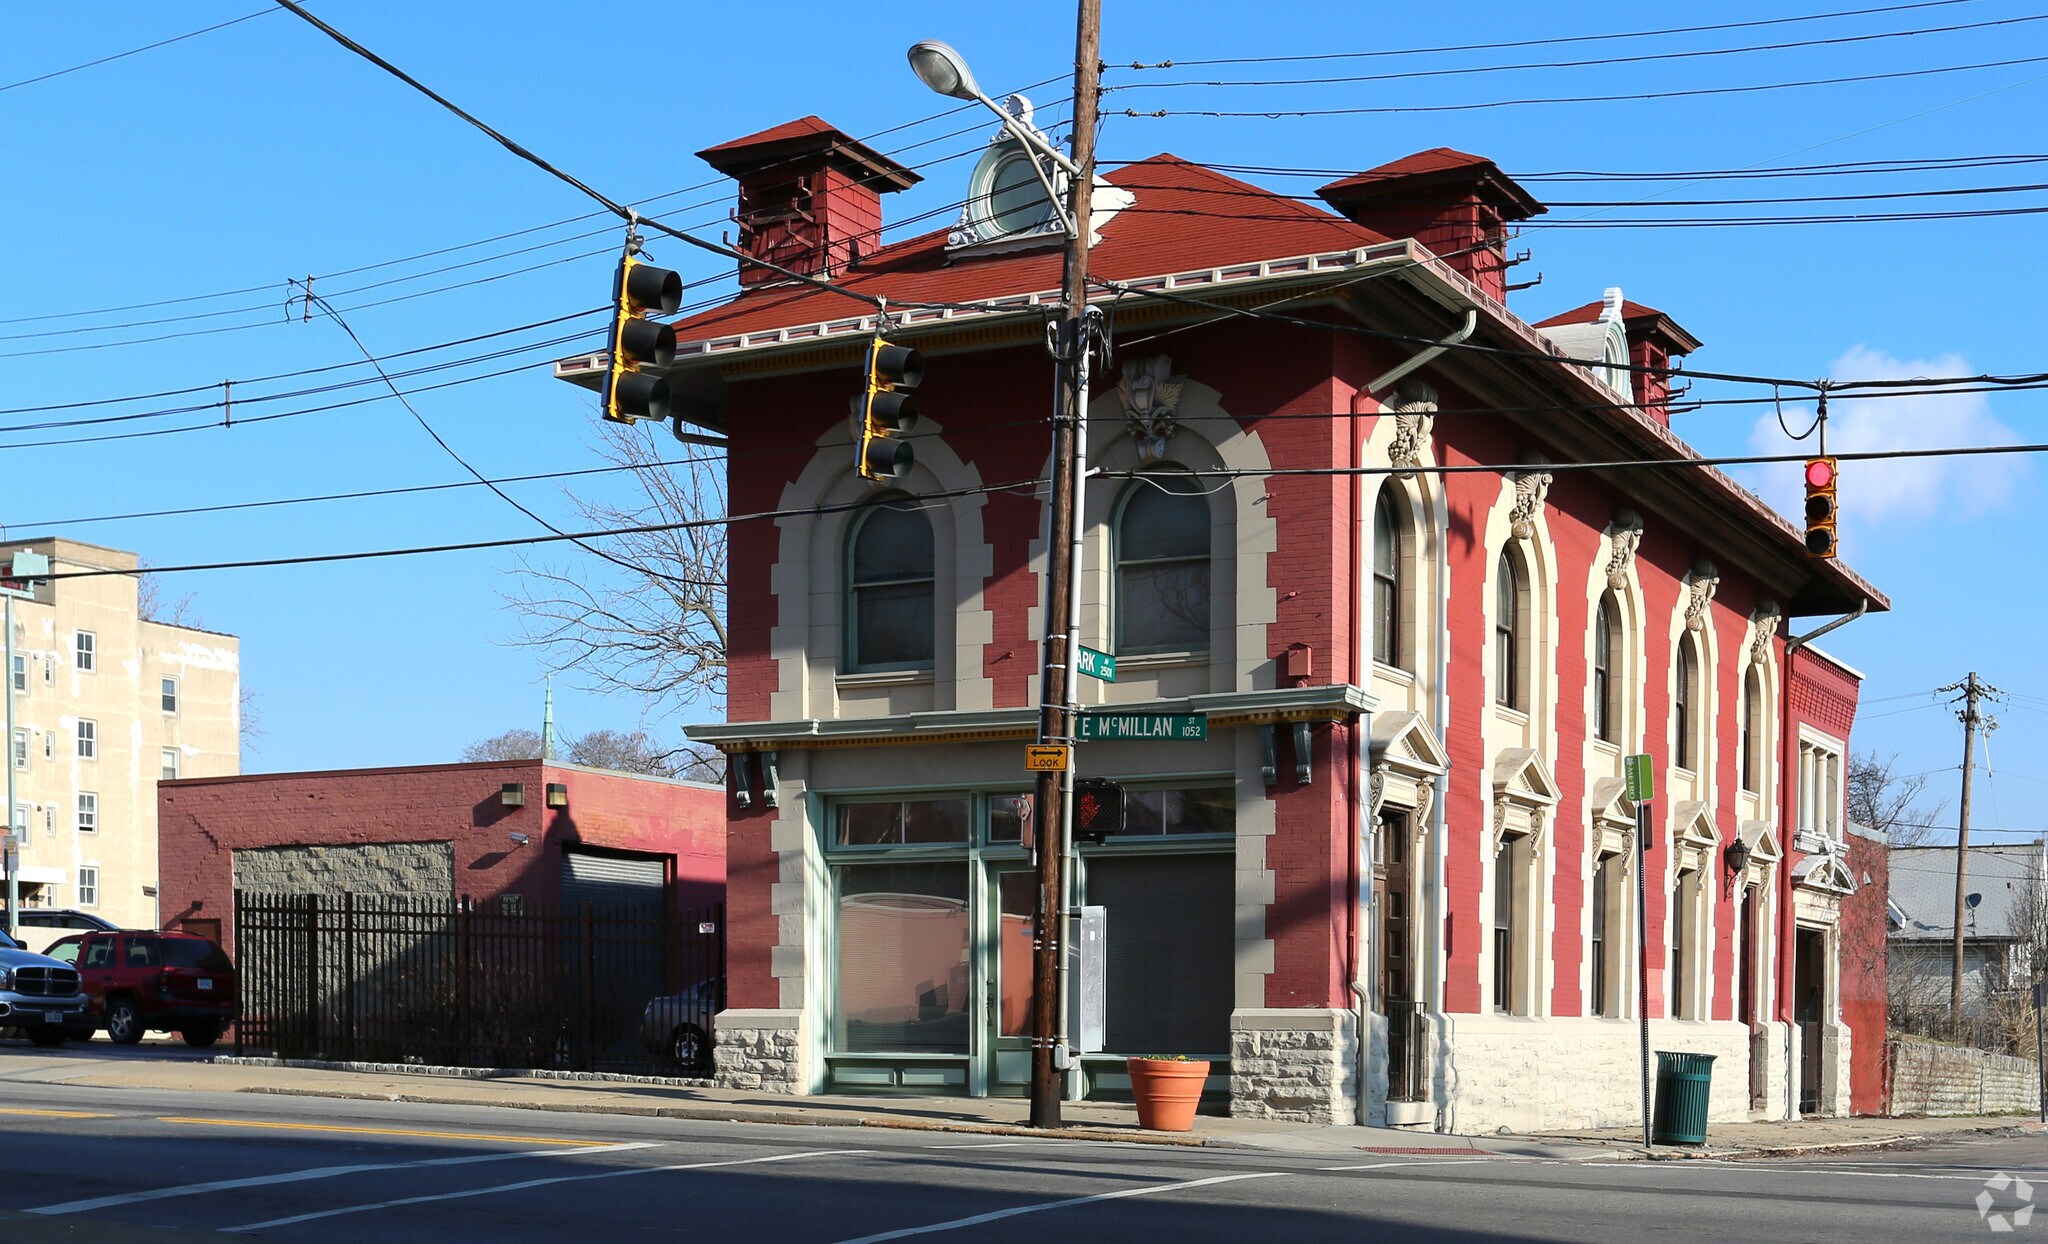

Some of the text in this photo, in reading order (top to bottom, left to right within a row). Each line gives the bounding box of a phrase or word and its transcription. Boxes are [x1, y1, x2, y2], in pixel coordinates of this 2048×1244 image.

[1077, 649, 1095, 673] ARK
[1100, 665, 1113, 678] 2501
[1082, 717, 1091, 736] E
[1188, 717, 1195, 725] ST
[1182, 726, 1201, 737] 1052
[1033, 759, 1059, 767] LOOK
[1627, 768, 1636, 800] METRO
